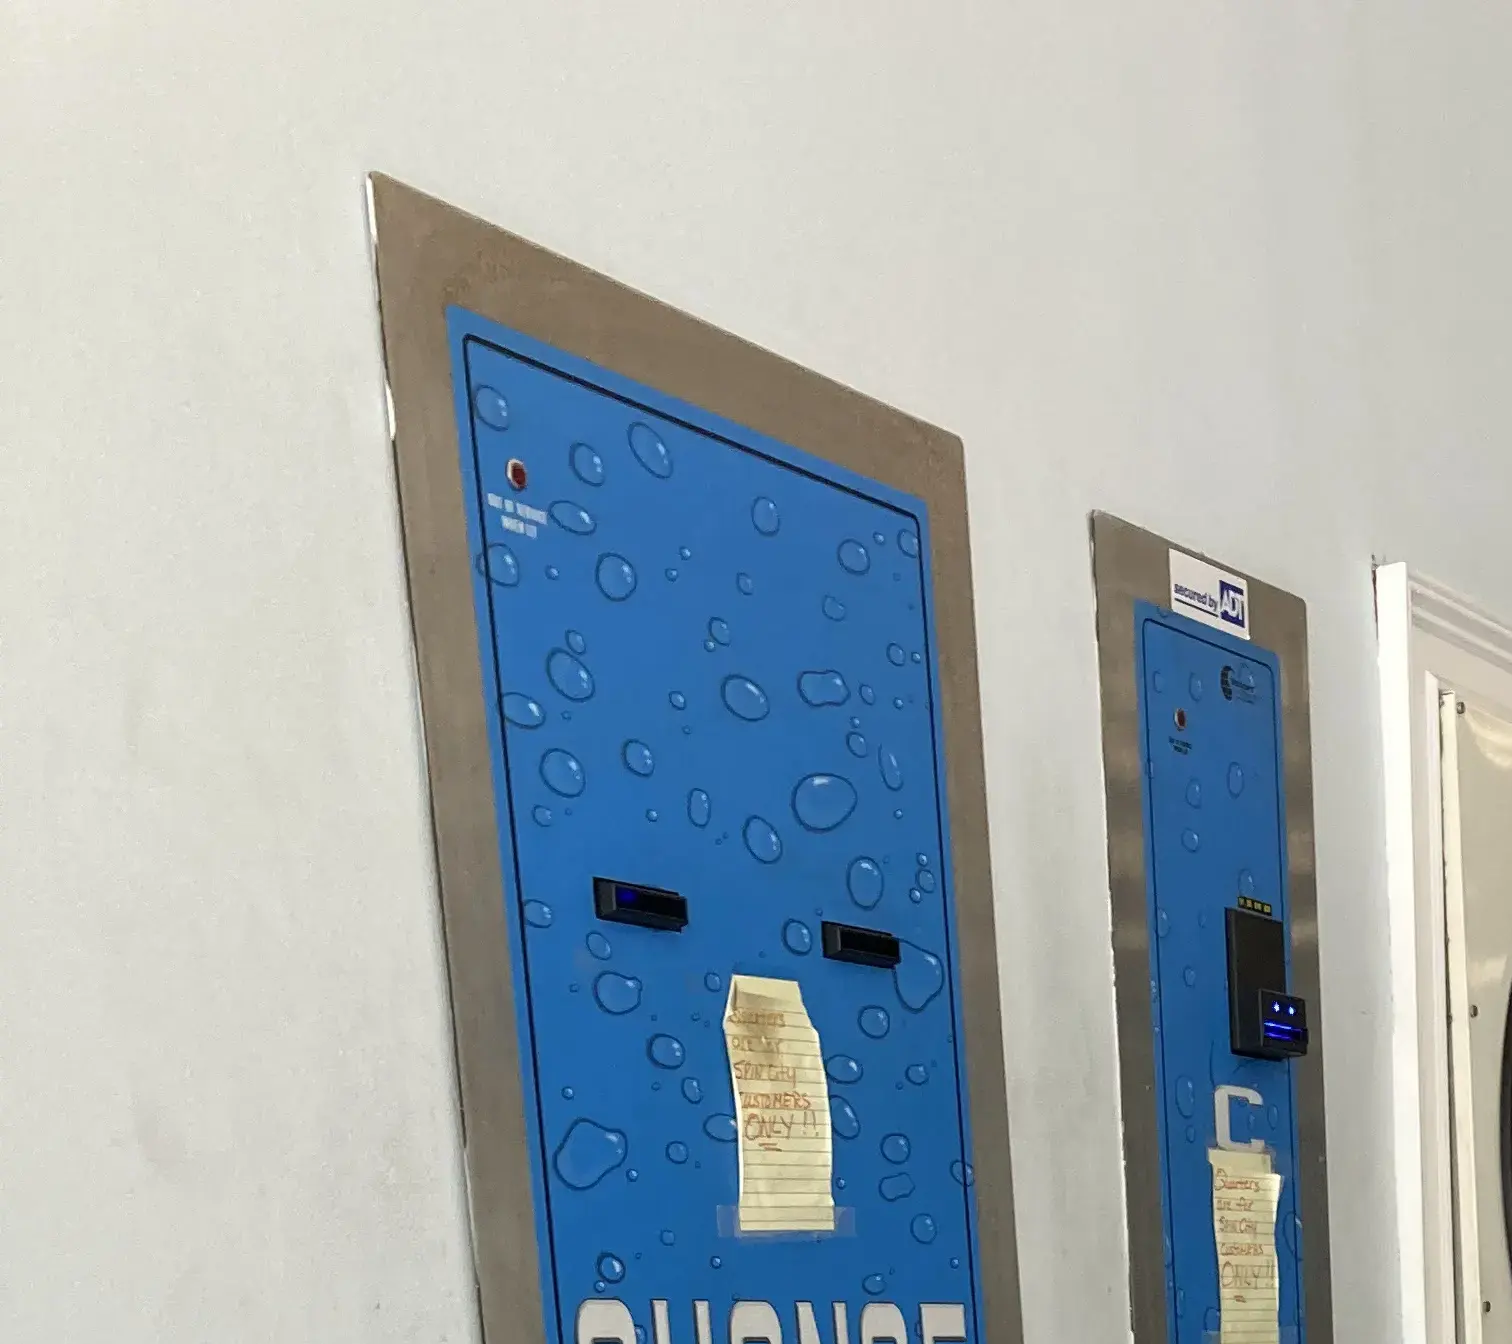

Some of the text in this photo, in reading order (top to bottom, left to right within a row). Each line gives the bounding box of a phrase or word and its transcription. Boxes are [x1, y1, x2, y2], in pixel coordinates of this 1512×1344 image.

[1174, 583, 1207, 605] secured
[1220, 587, 1245, 621] ADT
[744, 1112, 793, 1140] ONLY
